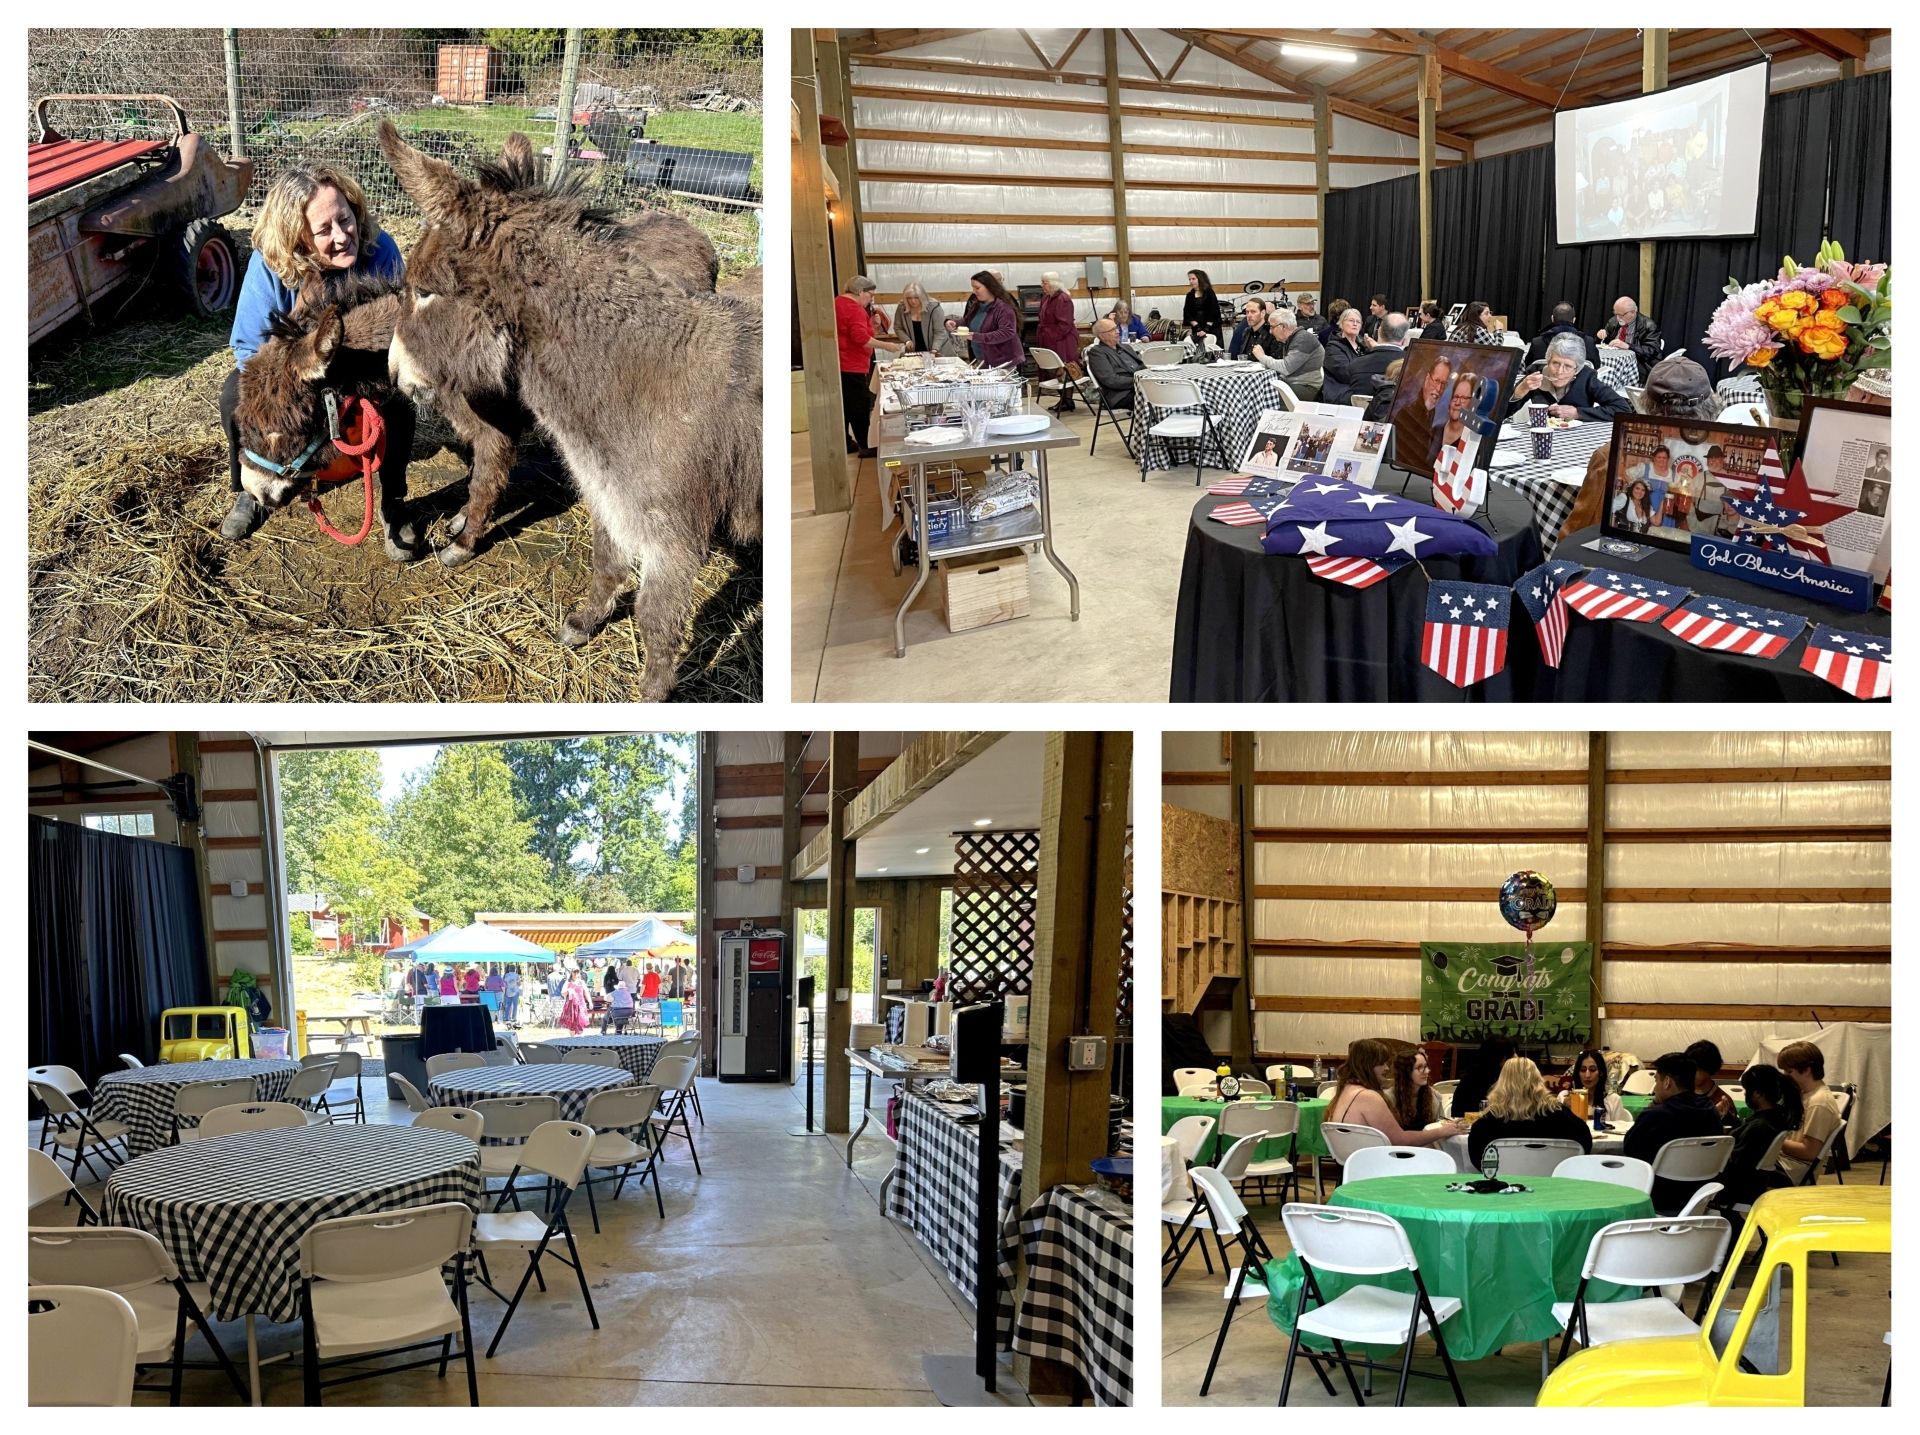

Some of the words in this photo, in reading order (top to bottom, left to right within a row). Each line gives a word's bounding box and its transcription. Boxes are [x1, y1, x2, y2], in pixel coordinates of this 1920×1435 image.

[1700, 544, 1732, 566] God
[1733, 553, 1780, 577] Bless
[1781, 567, 1854, 595] America
[1457, 966, 1554, 994] Congrats
[1466, 999, 1545, 1021] GRAD!
